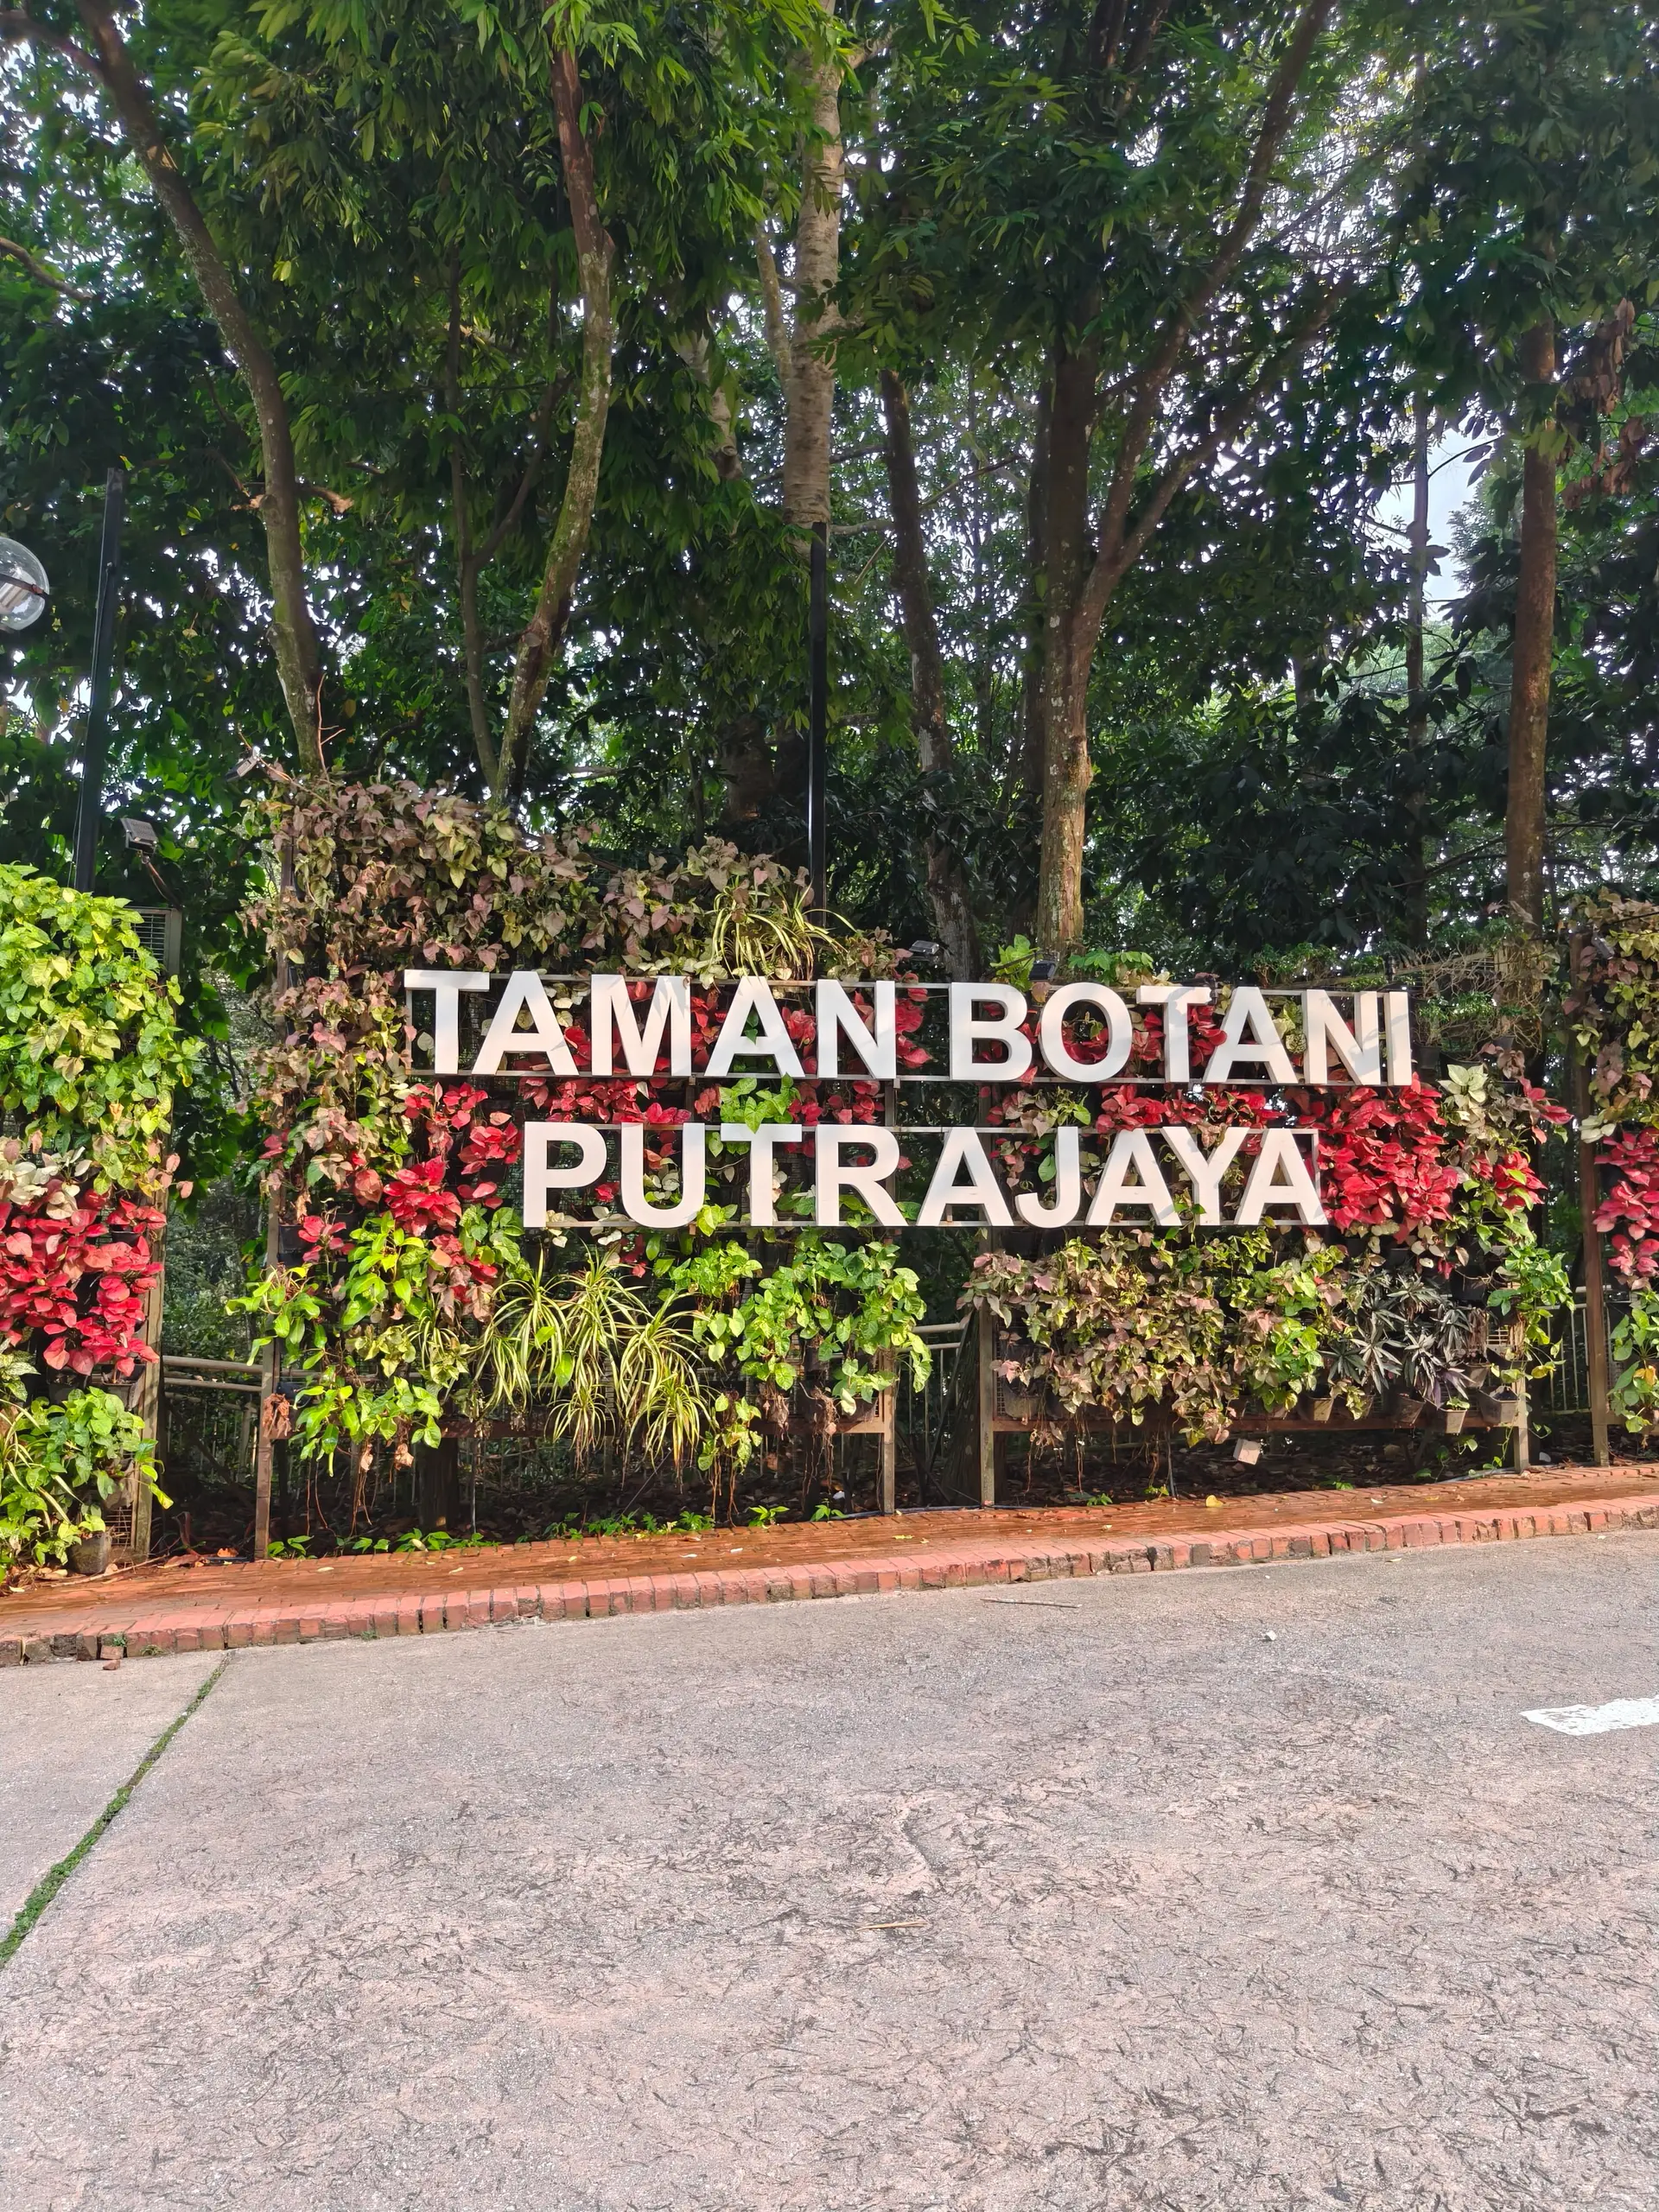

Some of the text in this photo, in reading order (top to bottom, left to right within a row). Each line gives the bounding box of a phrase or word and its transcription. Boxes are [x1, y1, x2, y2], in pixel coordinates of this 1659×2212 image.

[404, 969, 1413, 1086] TAMAN BOTANI
[523, 1121, 1329, 1229] PUTRAJAYA
